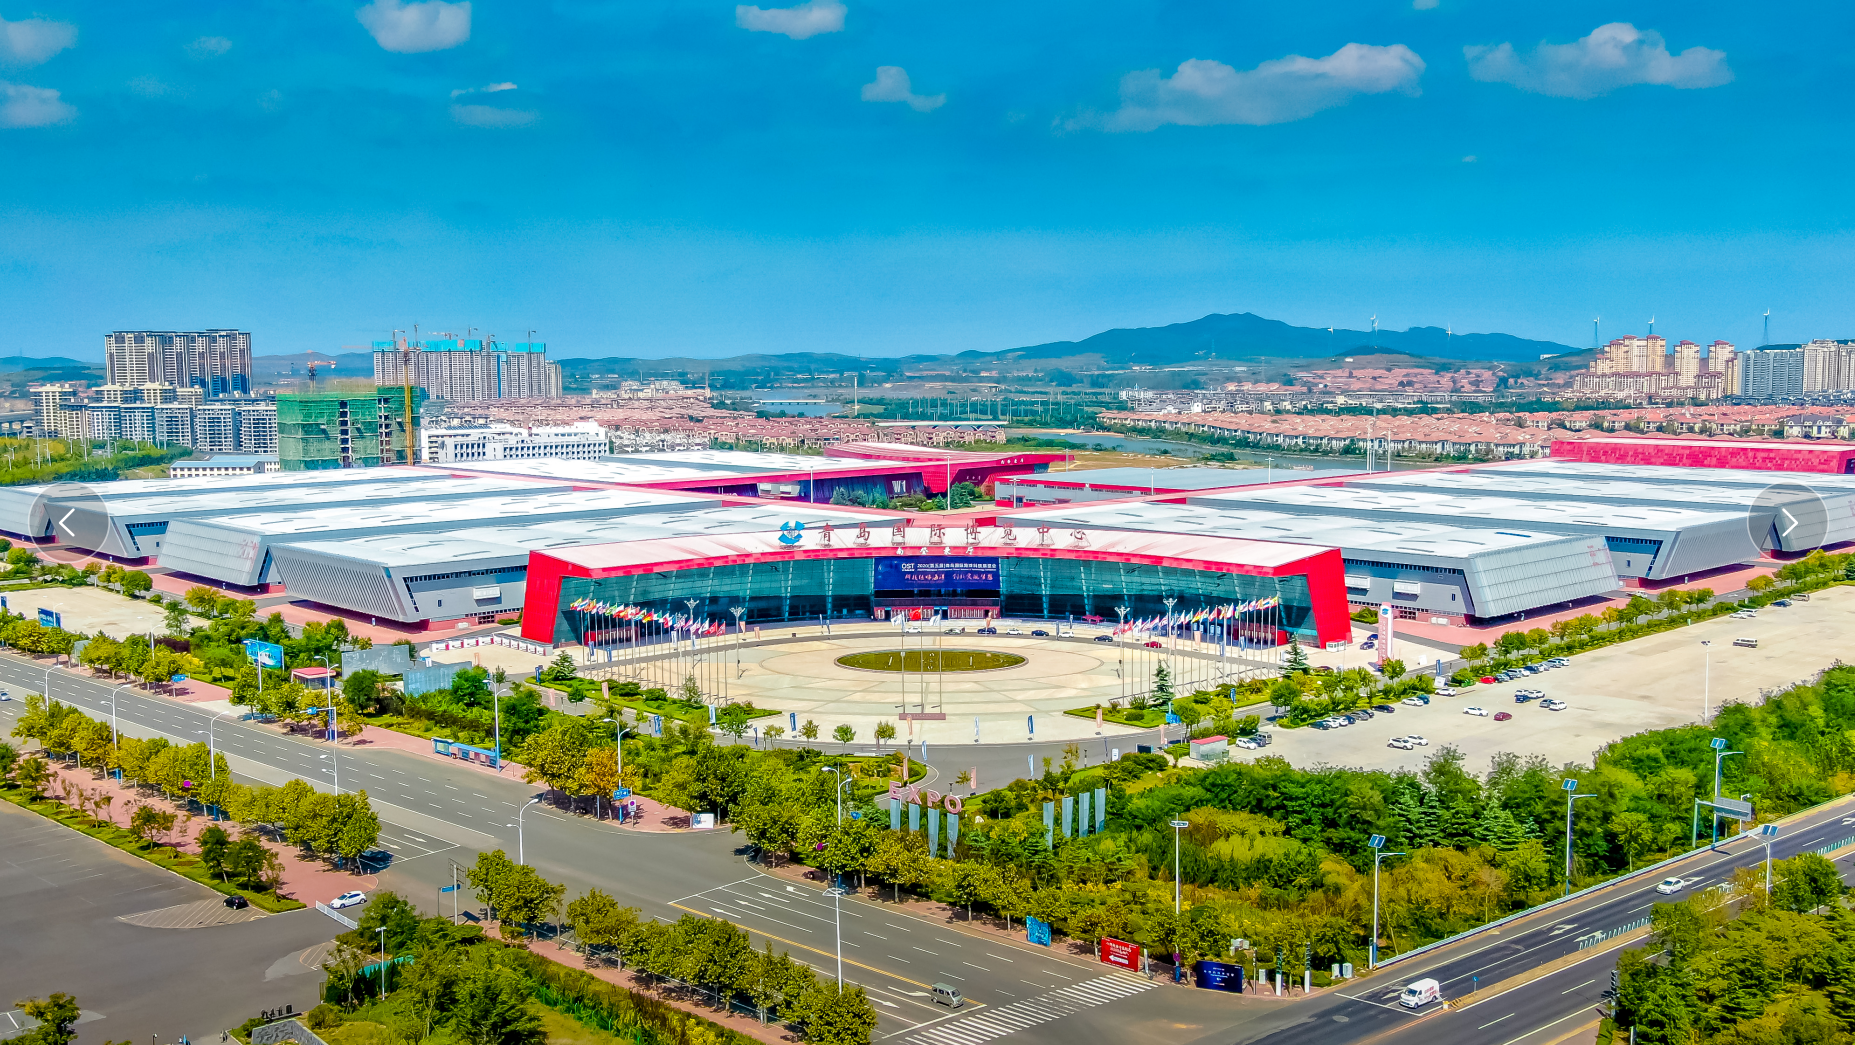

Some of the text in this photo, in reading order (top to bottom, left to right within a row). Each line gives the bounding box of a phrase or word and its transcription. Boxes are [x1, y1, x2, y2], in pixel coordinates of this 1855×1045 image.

[892, 480, 906, 492] W1
[819, 522, 1087, 542] 青岛国际博览中心
[889, 781, 962, 814] EXPO
